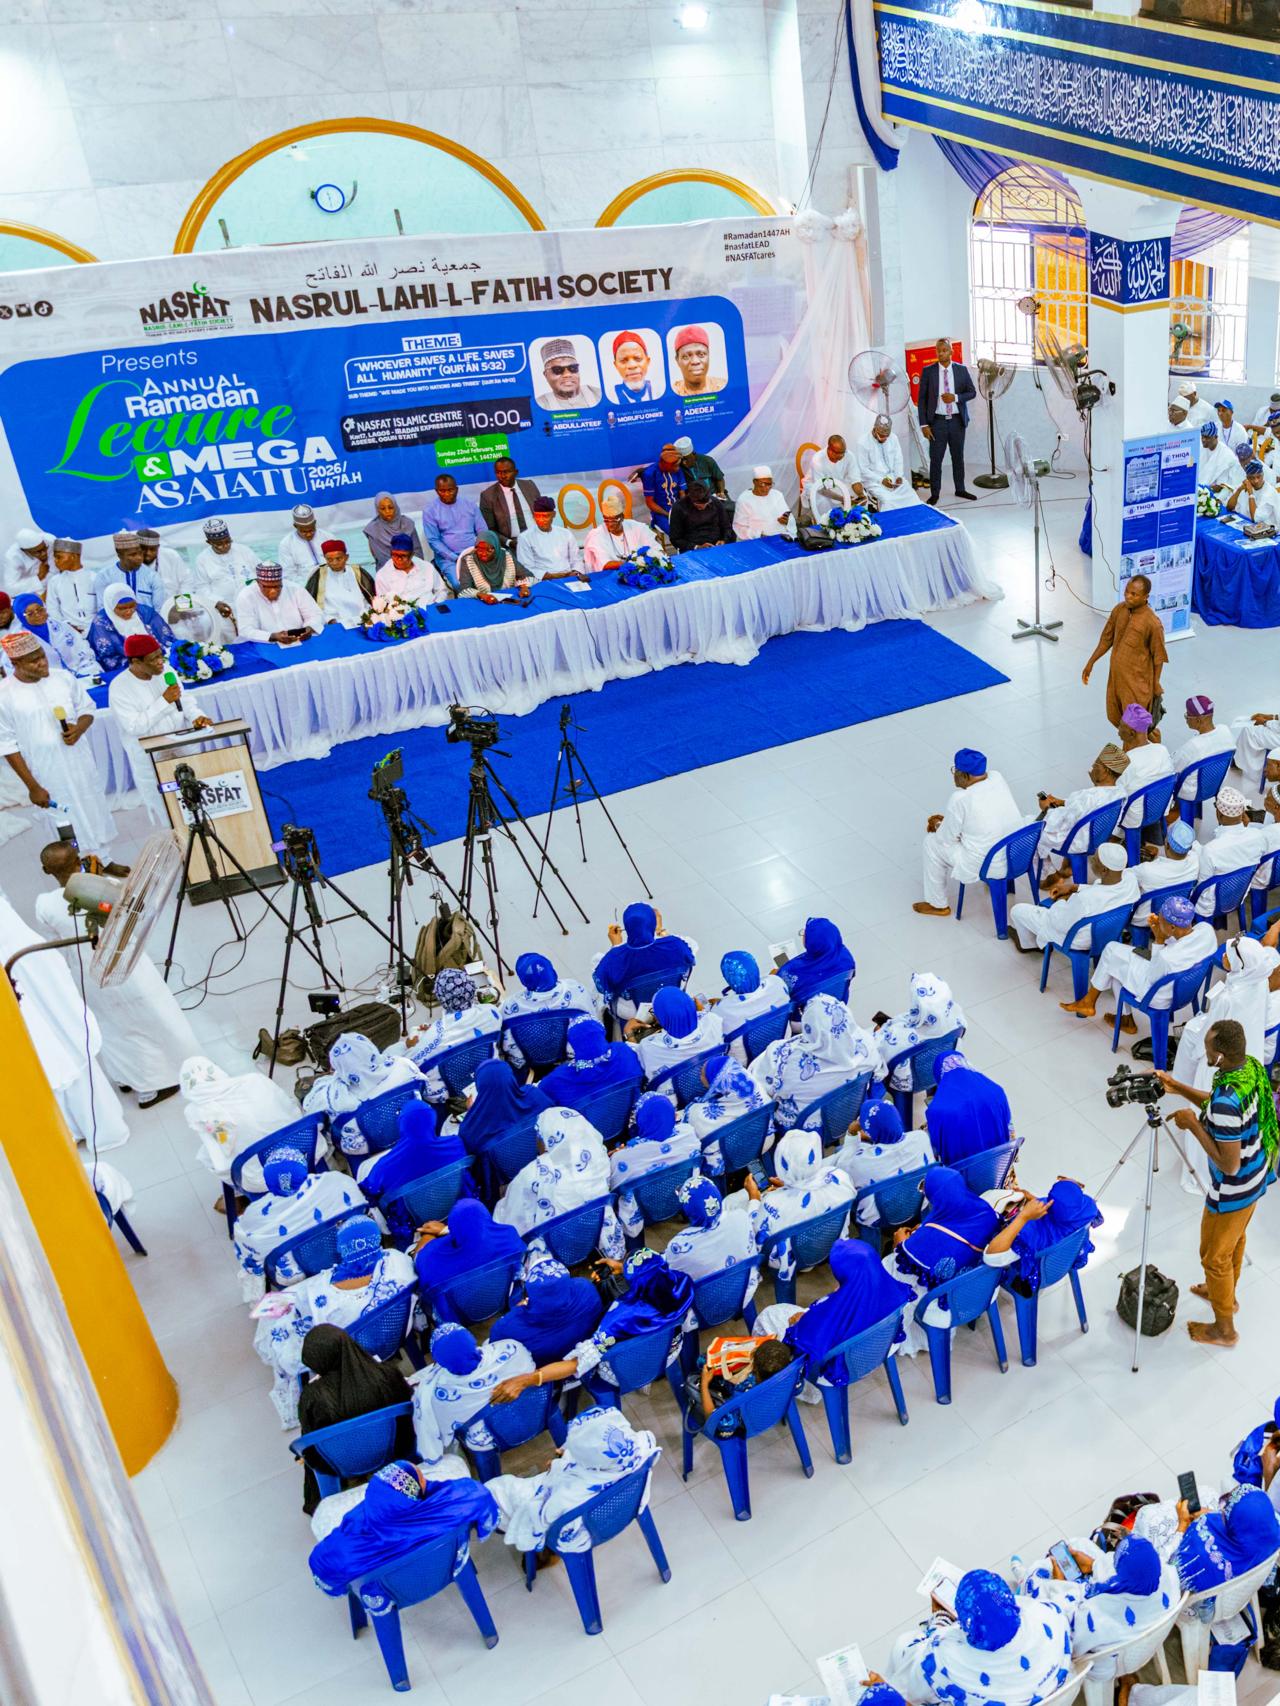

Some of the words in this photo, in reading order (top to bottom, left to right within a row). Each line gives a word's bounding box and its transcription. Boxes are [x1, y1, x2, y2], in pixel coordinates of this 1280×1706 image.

[723, 229, 791, 241] #Ramadan1447AH
[724, 240, 770, 251] #nasfatLEAD
[432, 257, 481, 276] جمعية
[725, 251, 776, 262] #NASFATcares
[305, 264, 353, 289] الفاتح
[389, 261, 425, 280] نصر
[250, 276, 553, 324] NASRUL-LAHI-L-FATIH
[558, 267, 673, 299] SOCIETY
[139, 290, 230, 324] NASFAT
[404, 335, 460, 350] THEME:
[101, 348, 198, 374] Presents
[354, 358, 412, 372] "WHOEVER
[414, 355, 446, 365] SAVES
[448, 354, 456, 363] A
[483, 349, 515, 359] SAVES
[356, 373, 378, 384] ALL
[381, 366, 437, 381] HUMANITY"
[142, 373, 246, 398] ANNUAL
[125, 385, 259, 419] Ramadan
[357, 418, 391, 432] NASFAT
[393, 414, 427, 427] ISLAMIC
[429, 411, 463, 422] CENTRE
[468, 409, 520, 429] 10:00
[45, 379, 297, 482] Lecture
[368, 430, 390, 438] LAGOS
[395, 426, 419, 435] IBADAN
[142, 456, 167, 478] &
[168, 436, 337, 477] MEGA
[1172, 451, 1190, 459] THIQA
[308, 460, 347, 478] 2026/
[135, 467, 309, 513] ASALATU
[310, 471, 362, 491] 1447A.H
[199, 787, 241, 807] ASFAT
